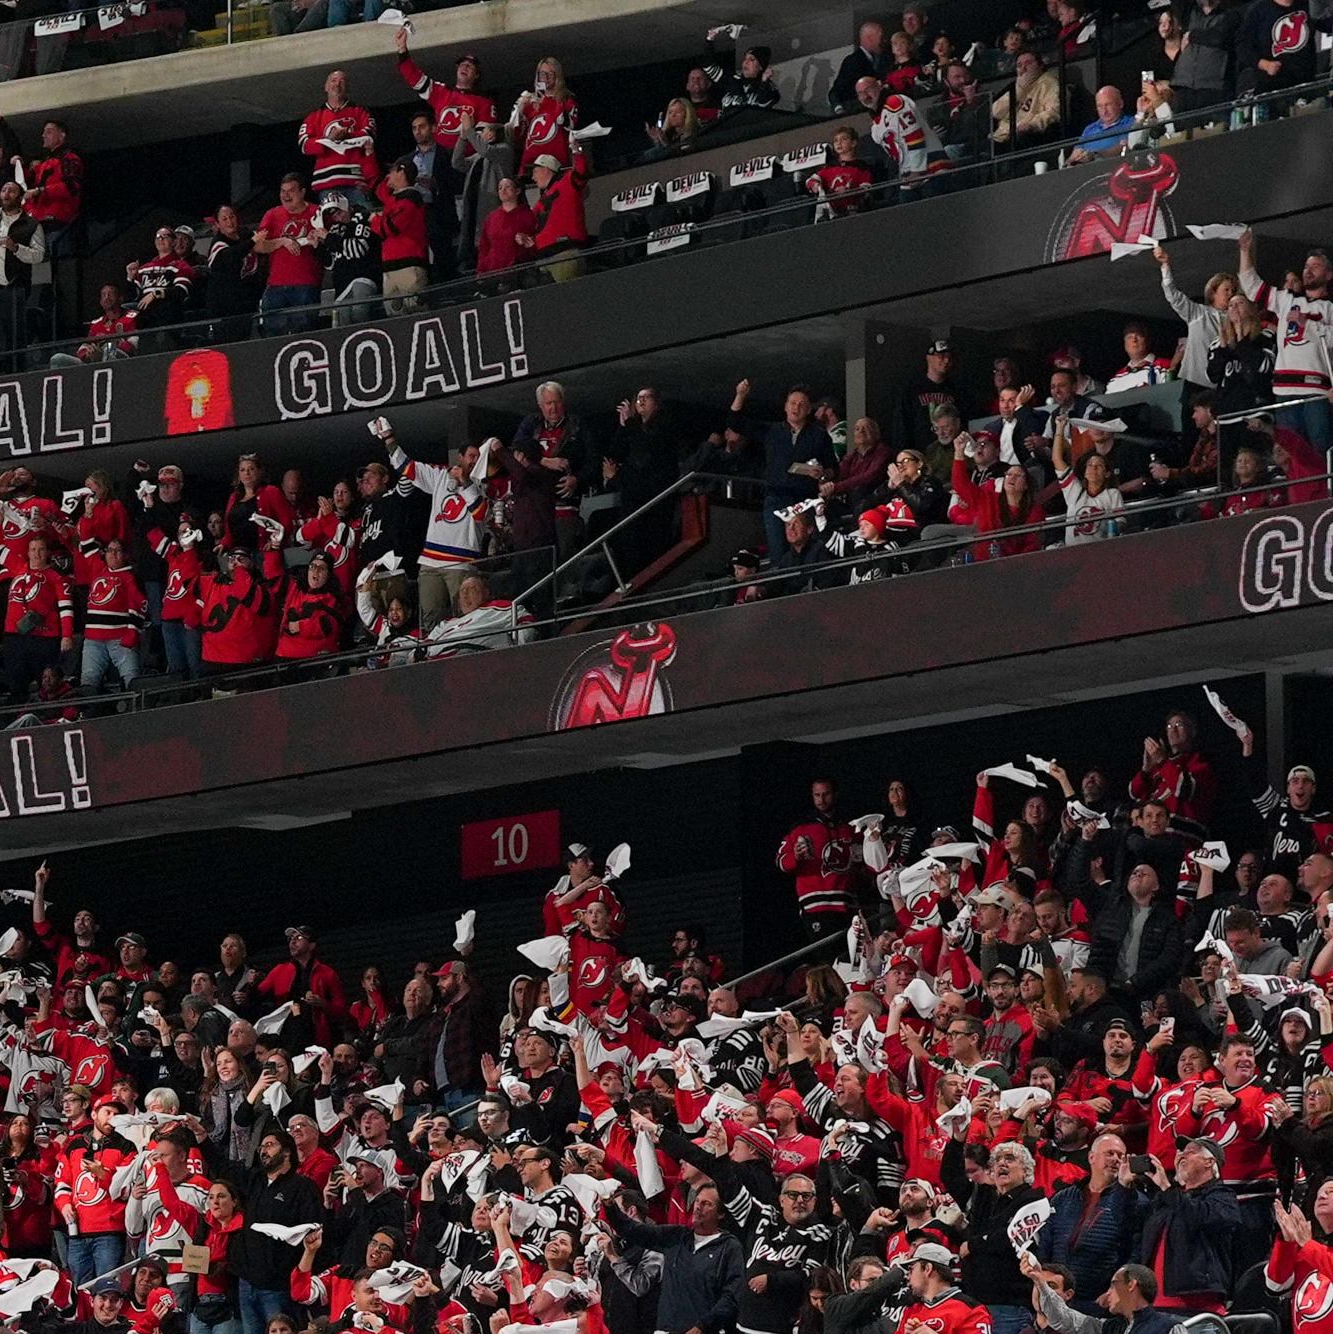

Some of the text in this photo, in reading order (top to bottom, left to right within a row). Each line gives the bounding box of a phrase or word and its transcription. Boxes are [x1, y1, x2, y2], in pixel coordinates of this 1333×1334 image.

[274, 299, 529, 421] GOAL!
[490, 823, 529, 864] 10
[558, 1202, 579, 1225] 13
[747, 1239, 807, 1268] Jersey
